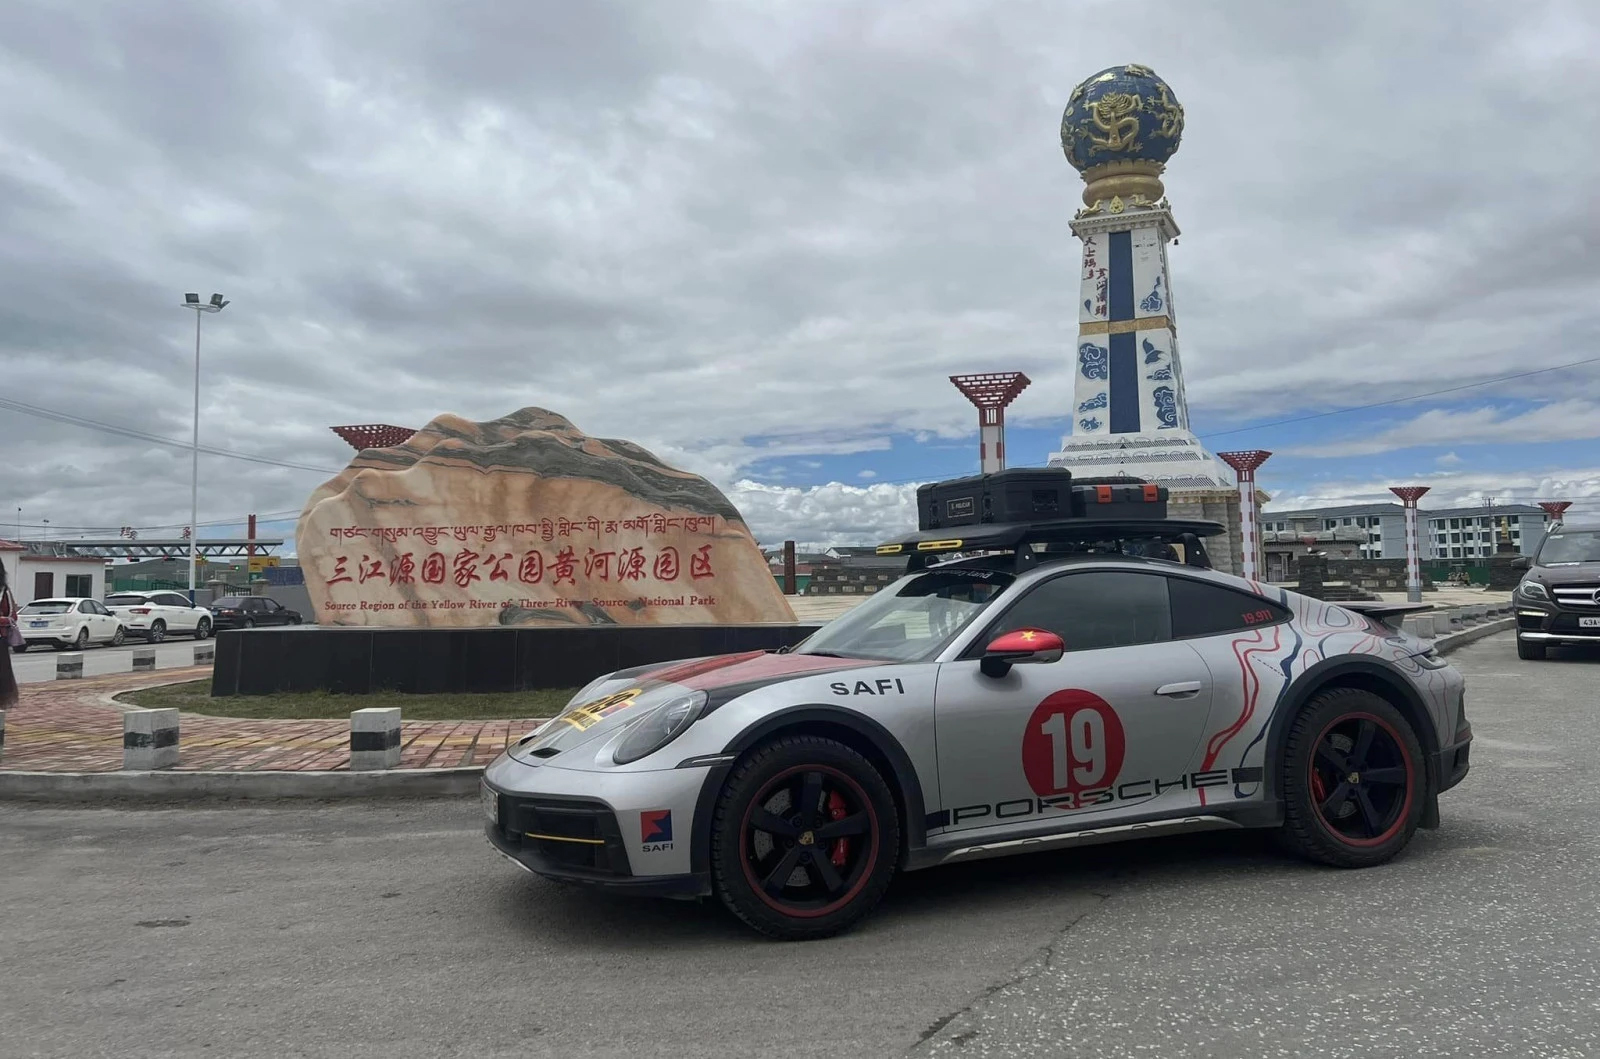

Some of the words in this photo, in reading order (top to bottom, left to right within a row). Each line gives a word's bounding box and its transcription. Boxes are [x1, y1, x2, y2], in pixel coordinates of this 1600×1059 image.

[326, 544, 716, 588] 三江源国家公园黄河源园区
[325, 601, 357, 610] Source
[360, 601, 395, 612] Region
[398, 600, 411, 610] of
[411, 600, 428, 609] the
[431, 600, 466, 609] Yellow
[469, 600, 497, 609] River
[592, 597, 628, 607] Source
[638, 596, 684, 607] National
[690, 595, 715, 606] Park
[830, 678, 904, 696] SAFI
[1041, 708, 1107, 790] 19
[953, 770, 1228, 825] PORSCHE
[642, 843, 674, 853] SAFI
